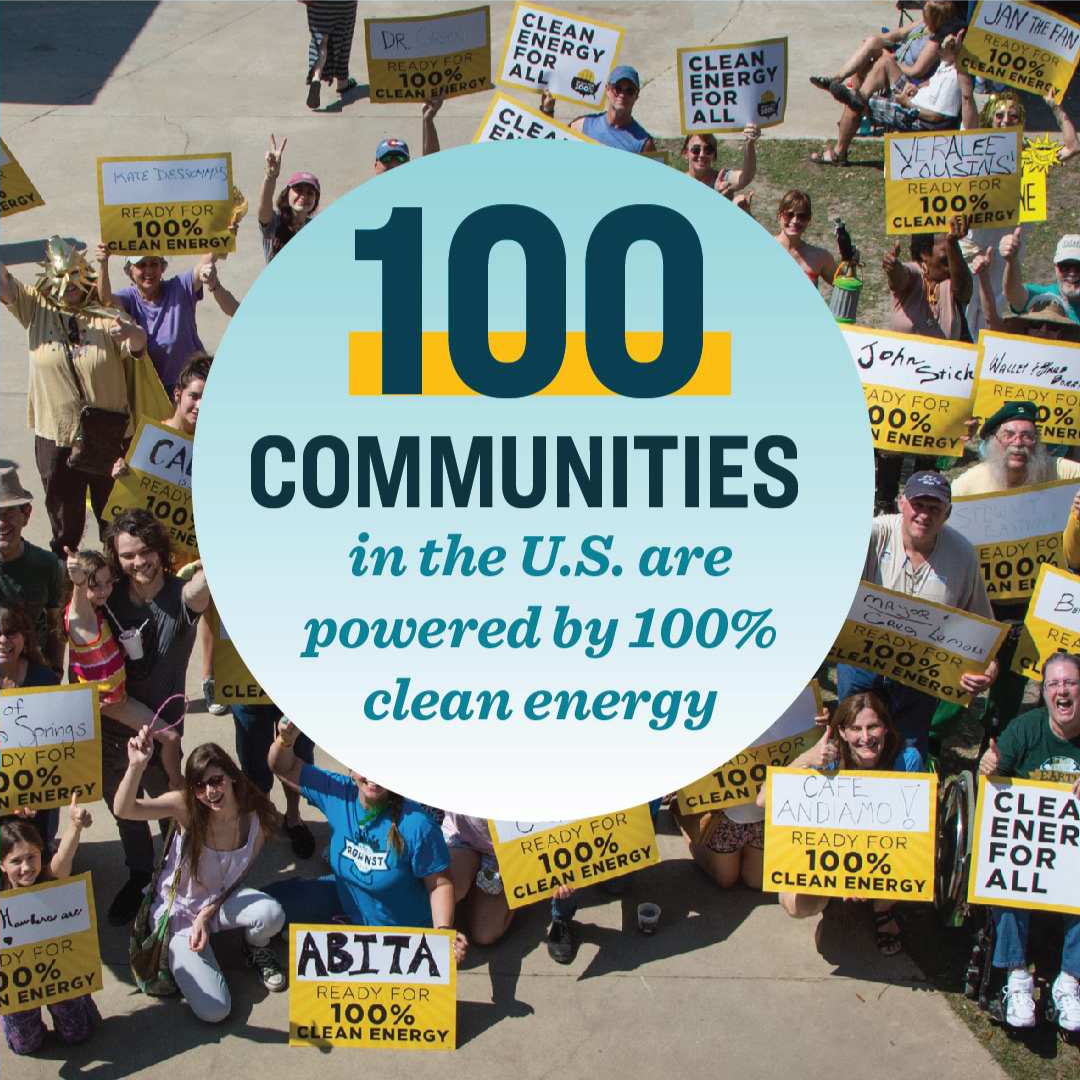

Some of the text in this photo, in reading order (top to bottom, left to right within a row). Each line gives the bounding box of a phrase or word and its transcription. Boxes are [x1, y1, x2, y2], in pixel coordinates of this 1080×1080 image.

[522, 12, 595, 44] CLEAN
[984, 2, 1079, 50] JAN THE FAN
[381, 30, 411, 50] DR.
[517, 28, 605, 63] ENERGY
[984, 33, 1059, 67] READY FOR
[388, 52, 473, 72] READY FOR
[513, 45, 557, 69] FOR
[688, 50, 764, 72] CLEAN
[989, 48, 1046, 78] 100%
[399, 66, 462, 88] 100%
[508, 63, 548, 85] ALL
[689, 66, 777, 89] ENERGY
[961, 58, 1060, 96] CLEAN ENERGY
[375, 76, 487, 99] CLEAN ENERGY
[691, 90, 738, 106] FOR
[692, 108, 735, 124] ALL
[114, 170, 149, 184] KATE
[908, 178, 1001, 194] READY FOR
[122, 204, 214, 218] READY FOR
[920, 193, 989, 214] 100%
[133, 219, 203, 238] 100%
[893, 216, 946, 228] CLEAN
[107, 236, 231, 251] CLEAN ENERGY
[857, 340, 925, 369] John
[912, 395, 950, 413] FOR
[994, 384, 1049, 402] READY
[886, 431, 960, 449] ENERGY
[140, 476, 192, 505] READY
[980, 542, 1029, 559] EADY
[980, 552, 1058, 580] 100%
[854, 624, 963, 669] READY FOR
[864, 639, 940, 678] 100%
[828, 647, 968, 699] CLEAN ENERGY
[3, 698, 24, 716] of
[15, 715, 87, 748] Springs
[35, 747, 76, 764] FOR
[767, 736, 805, 758] FOR
[18, 782, 96, 805] ENERGY
[686, 786, 750, 808] CLEAN
[803, 775, 869, 798] CAFE
[777, 800, 892, 825] ANDIAMO
[994, 791, 1080, 820] CLEA
[521, 825, 582, 855] READY
[590, 812, 627, 834] FOR
[792, 831, 907, 850] READY FOR
[990, 816, 1080, 847] ENER
[538, 833, 619, 874] 100%
[805, 849, 892, 875] 100%
[989, 842, 1056, 870] FOR
[513, 845, 651, 899] CLEAN ENERGY
[772, 871, 926, 893] CLEAN ENERGY
[985, 868, 1047, 894] ALL
[34, 939, 73, 960] FOR
[297, 932, 441, 978] ABITA
[18, 972, 95, 1004] ENERGY
[317, 986, 430, 1001] READY FOR
[331, 1003, 415, 1026] 100%
[297, 1025, 449, 1043] CLEAN ENERGY
